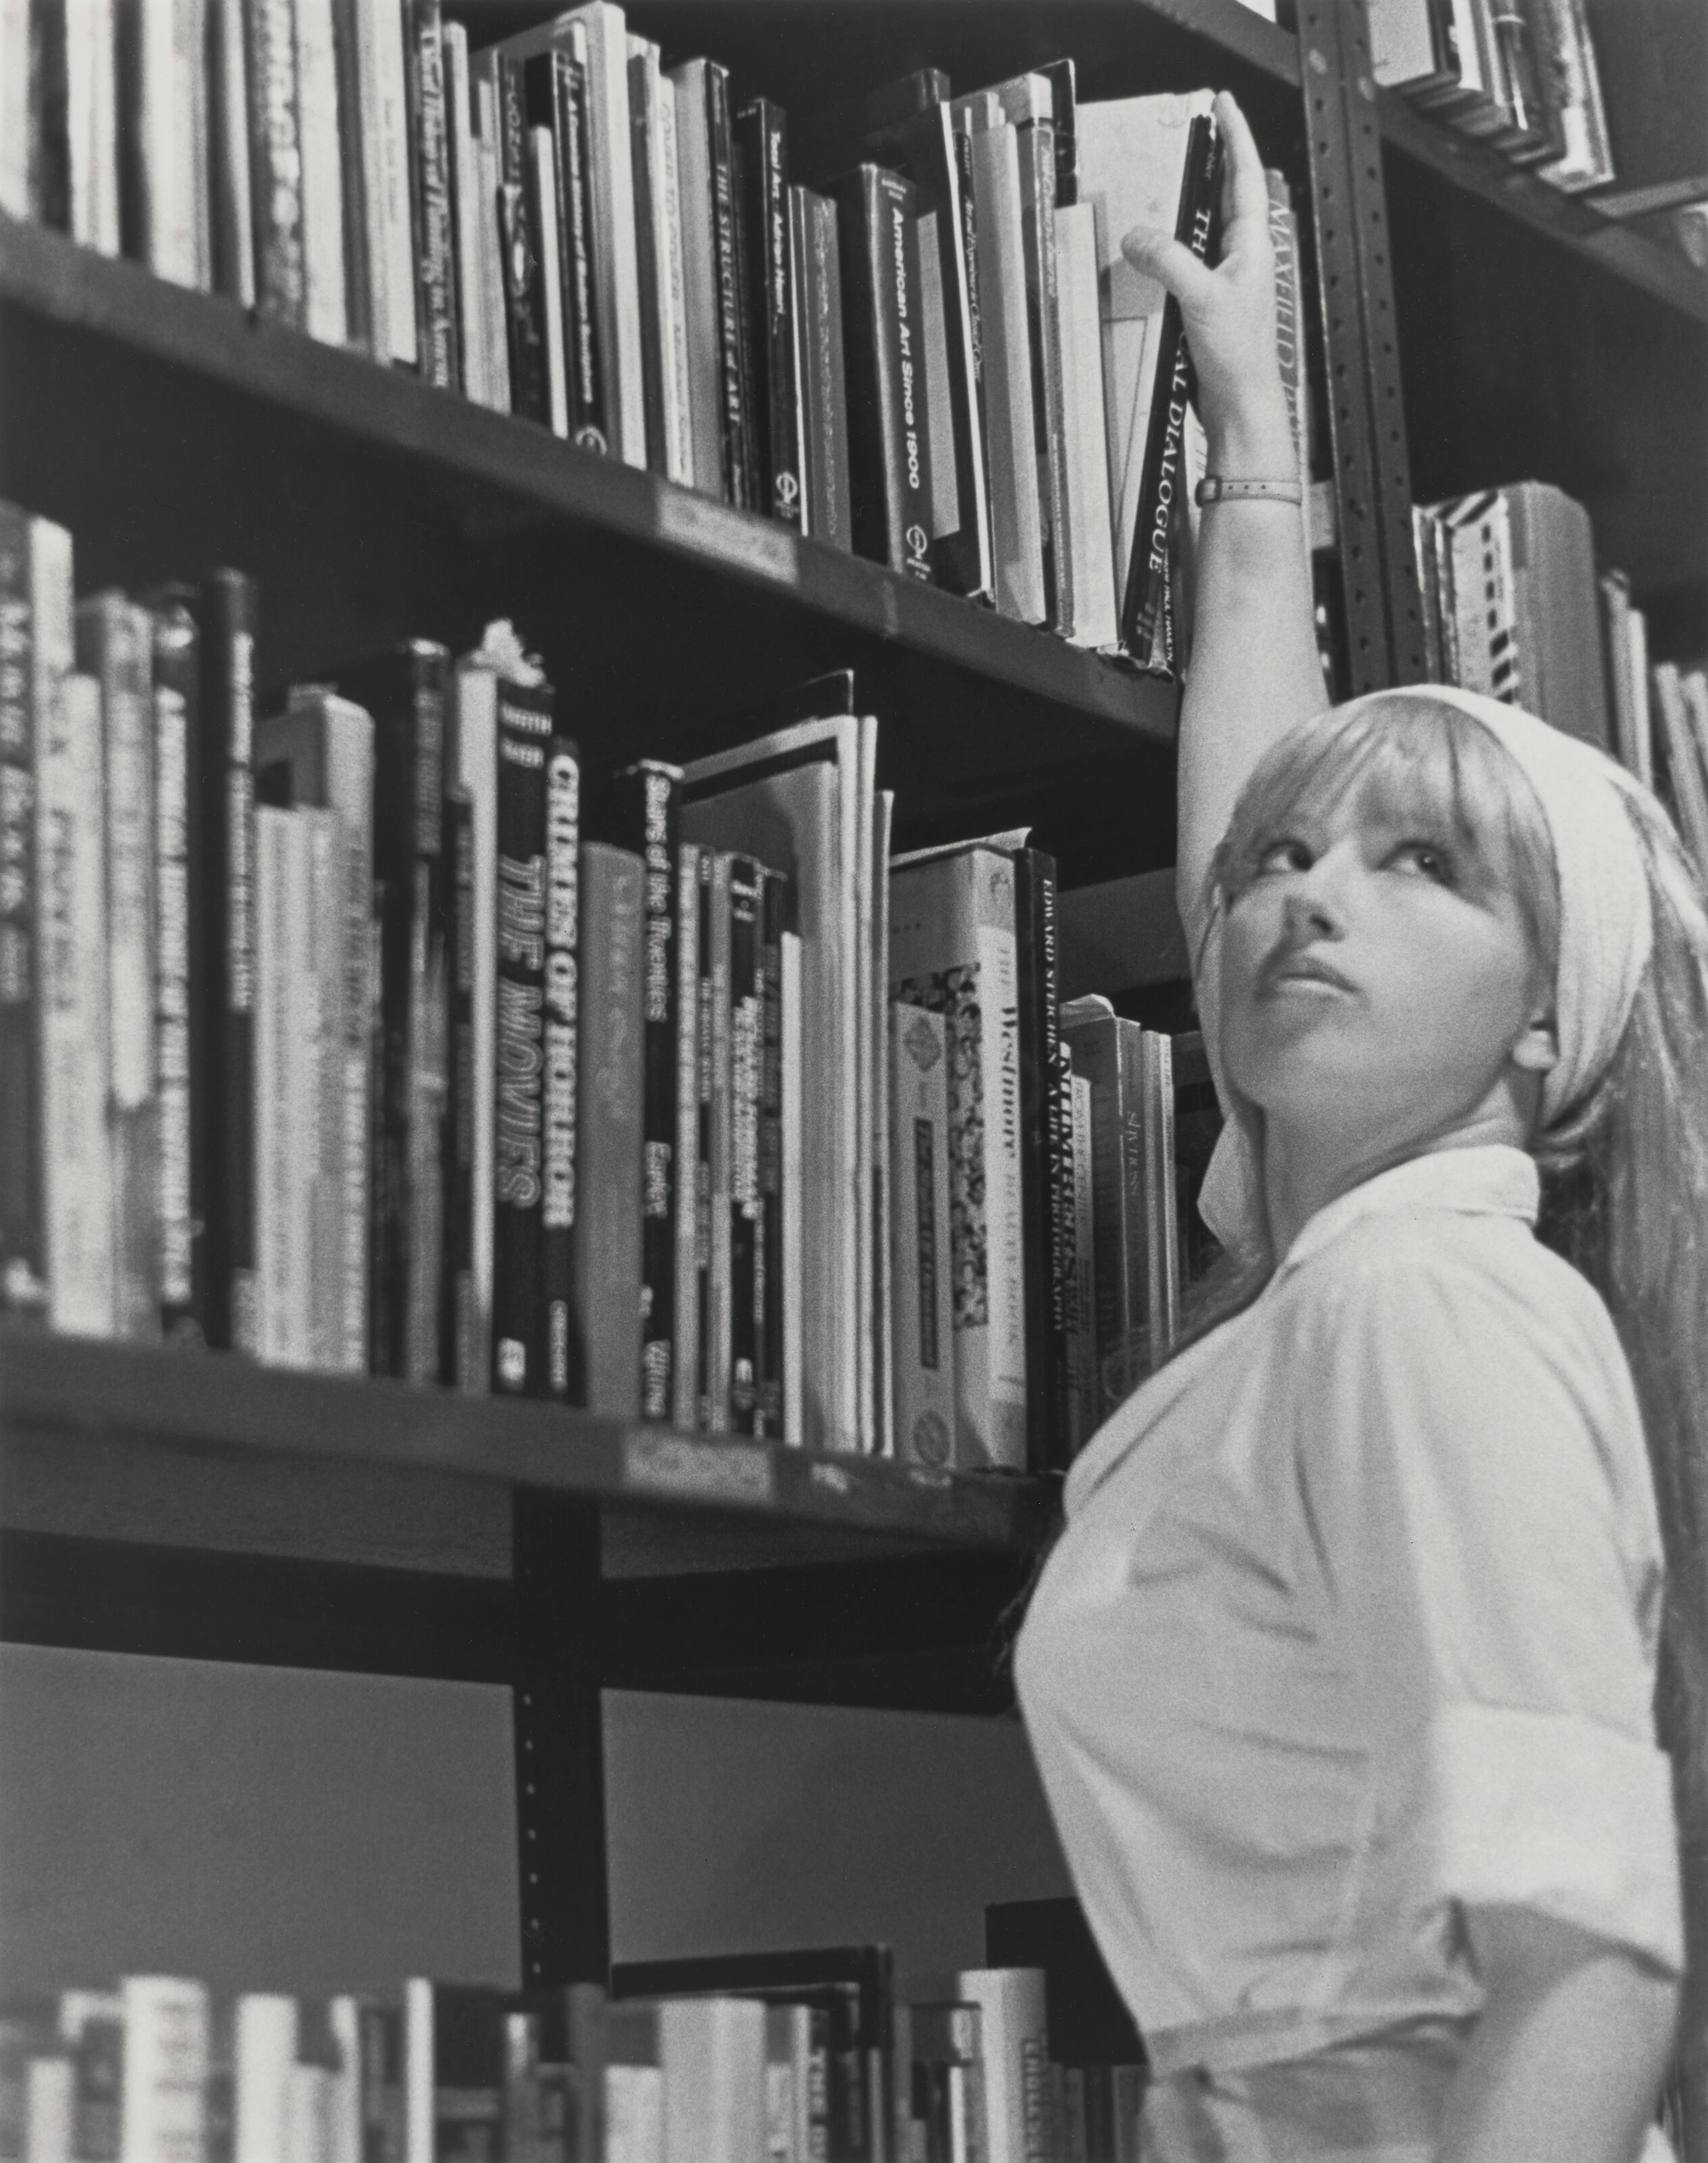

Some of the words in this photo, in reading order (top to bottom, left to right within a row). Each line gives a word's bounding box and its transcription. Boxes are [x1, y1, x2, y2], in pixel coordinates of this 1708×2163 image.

[716, 163, 729, 203] THE
[892, 208, 908, 318] American
[1192, 209, 1211, 253] TH
[899, 322, 910, 355] Art
[902, 360, 914, 426] Since
[906, 431, 920, 489] 1900
[1149, 400, 1182, 574] DIALOGUE
[495, 854, 547, 971] THE
[1043, 879, 1056, 962] EDWARD
[494, 977, 544, 1208] MOVIES
